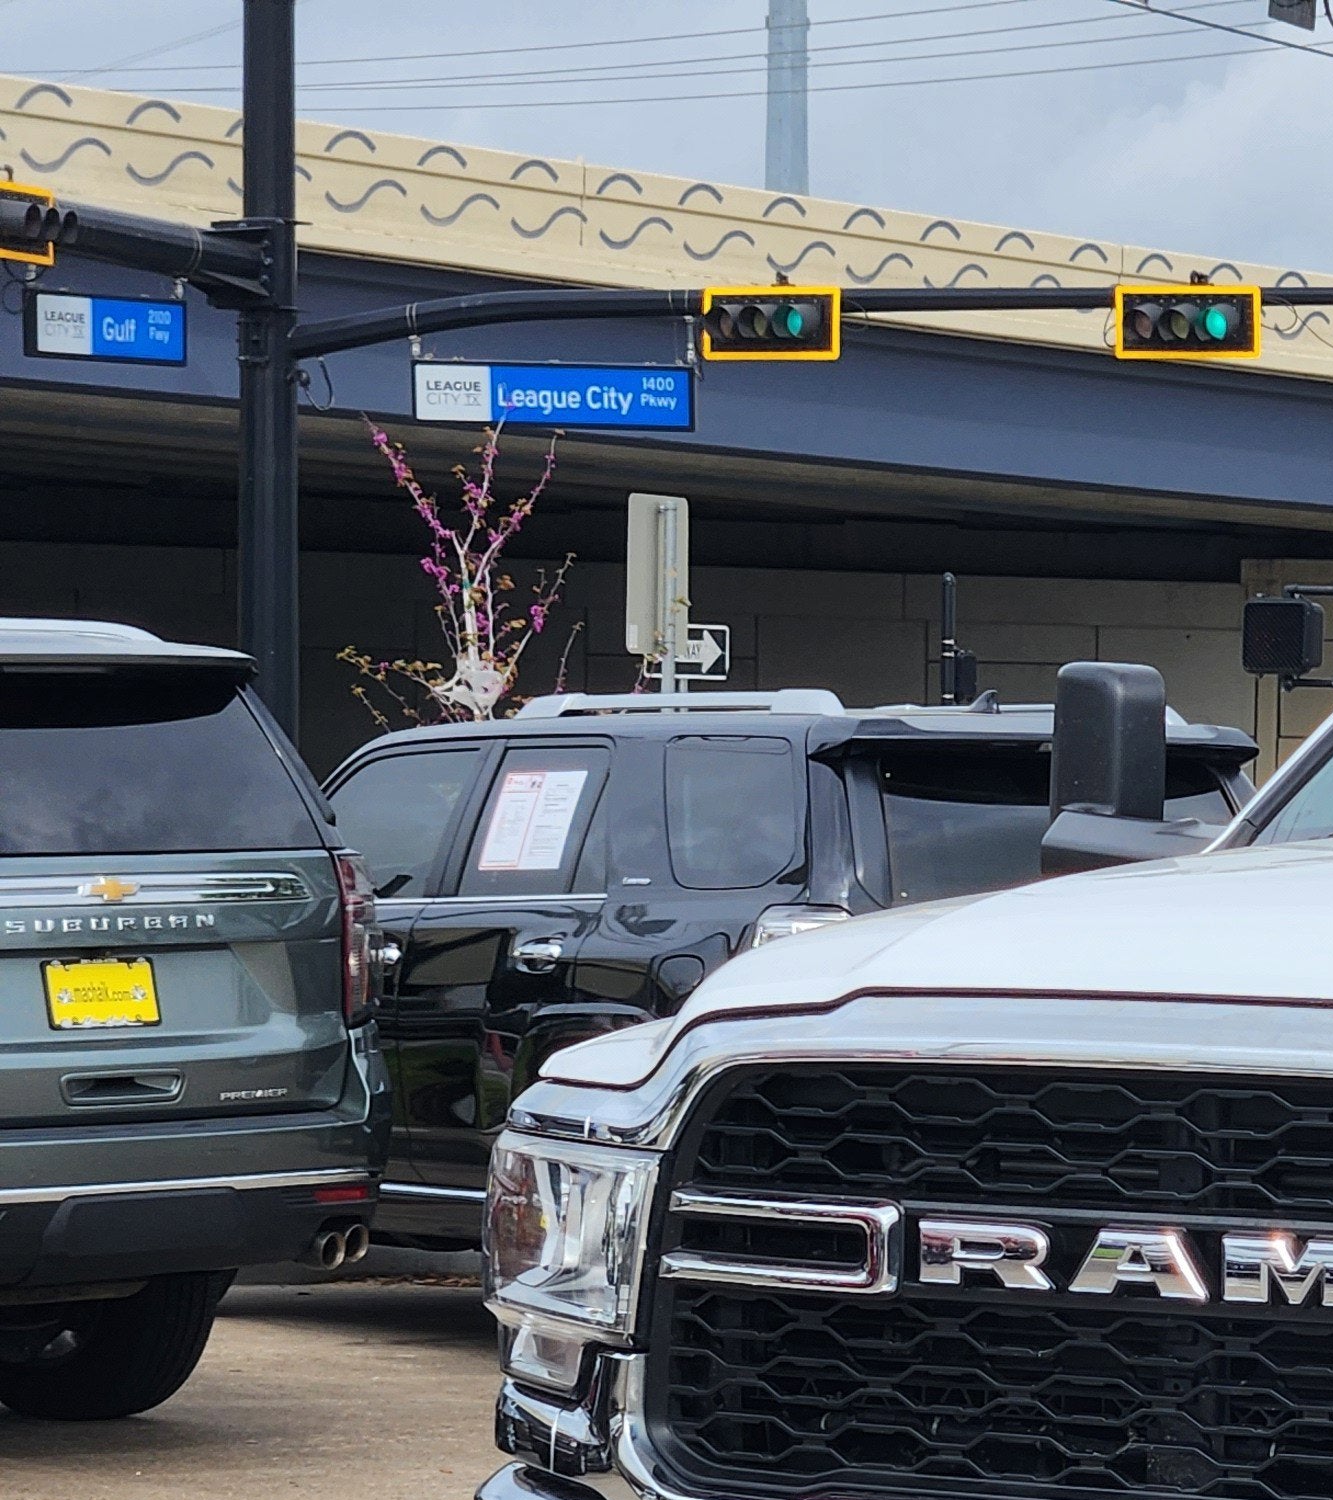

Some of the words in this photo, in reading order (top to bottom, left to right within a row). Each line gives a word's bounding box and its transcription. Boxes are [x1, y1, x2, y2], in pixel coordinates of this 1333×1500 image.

[44, 309, 86, 324] LEAGUE
[148, 309, 172, 325] 2100
[102, 316, 137, 343] Gulf
[149, 326, 170, 344] Fwy
[426, 380, 482, 392] LEAGUE
[641, 376, 675, 391] 1400
[426, 392, 461, 406] CITY
[497, 384, 582, 415] League
[586, 385, 633, 415] City
[640, 393, 677, 411] Pkwy
[5, 914, 215, 935] SUBURBAN
[219, 1088, 288, 1101] PREMIER
